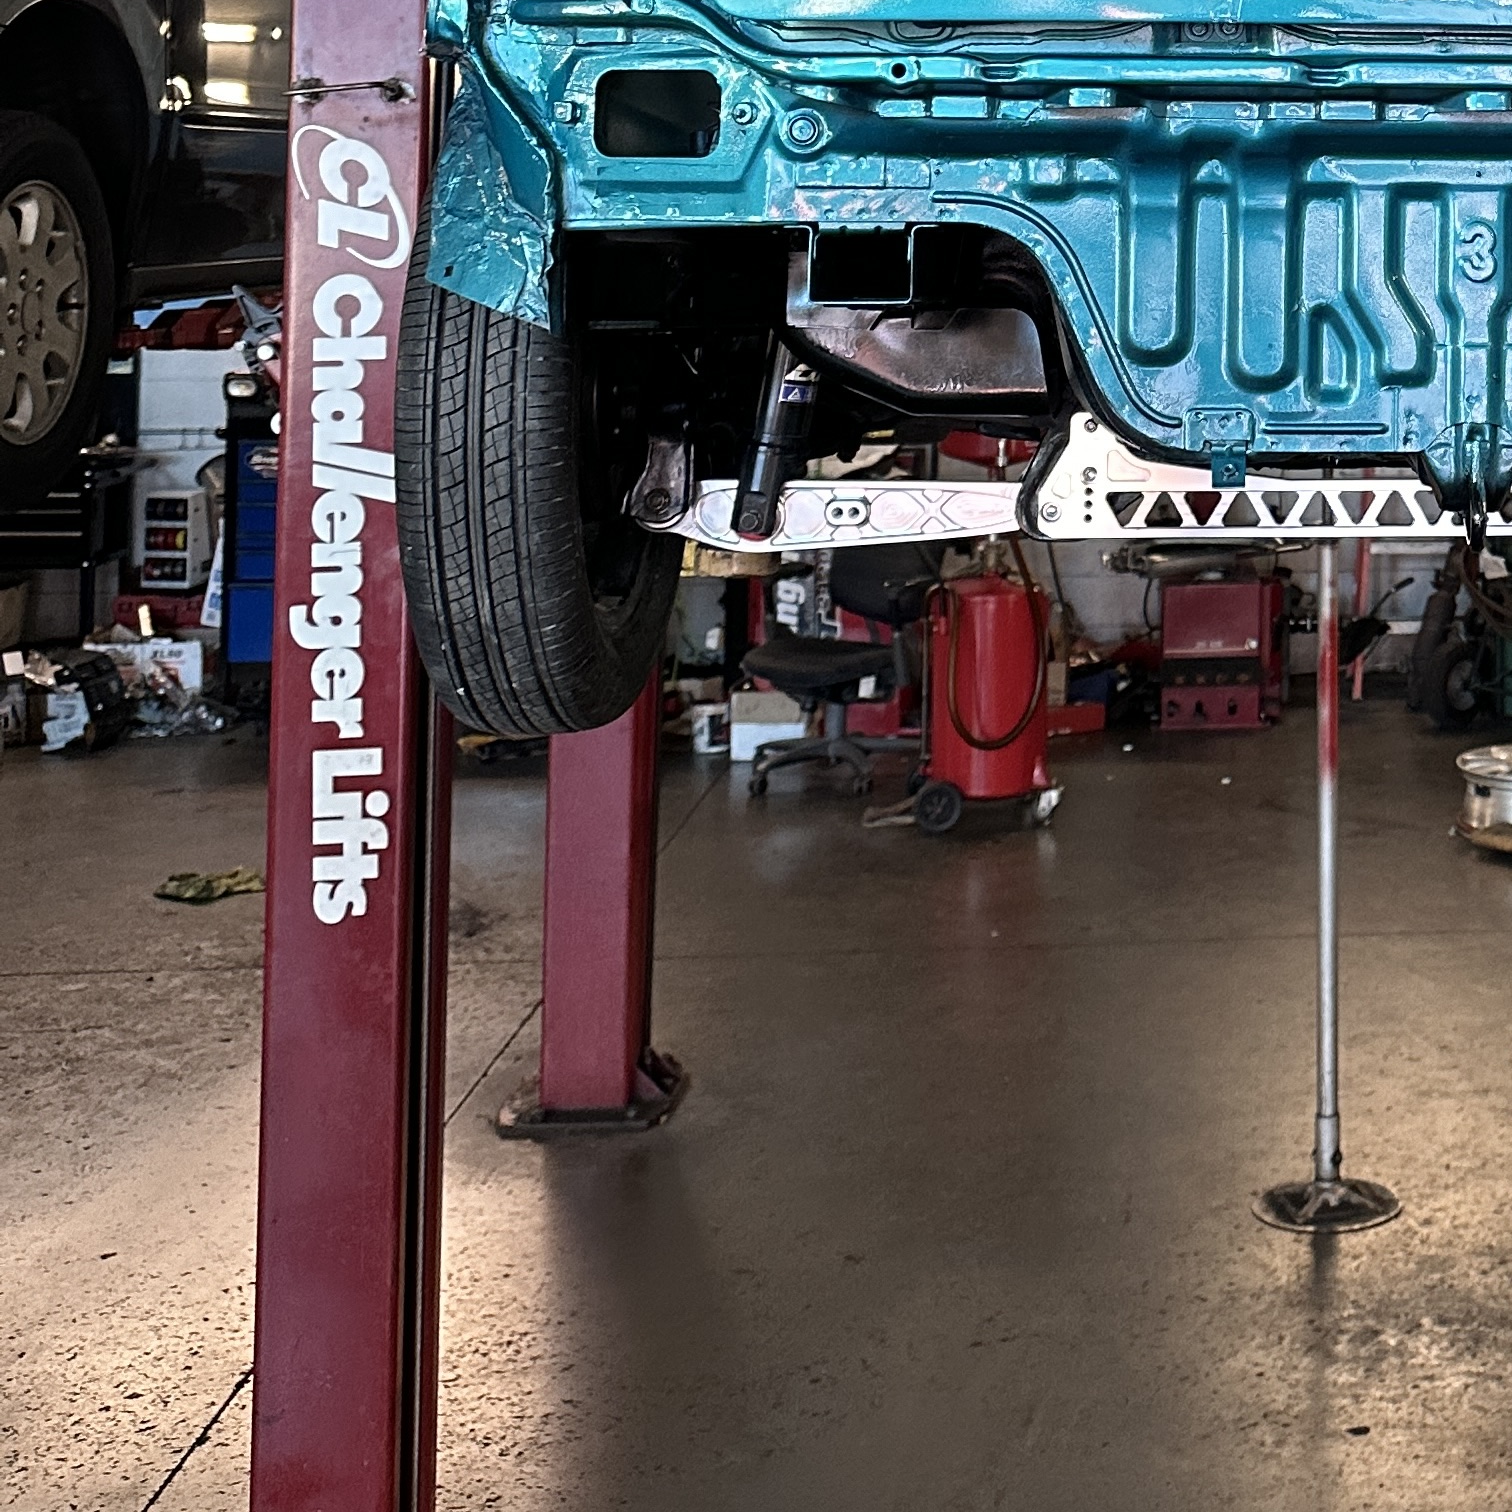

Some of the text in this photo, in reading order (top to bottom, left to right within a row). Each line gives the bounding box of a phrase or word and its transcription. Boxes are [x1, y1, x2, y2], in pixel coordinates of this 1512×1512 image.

[1459, 221, 1498, 283] 3
[289, 274, 396, 739] Challenger
[312, 747, 391, 925] Lifts
